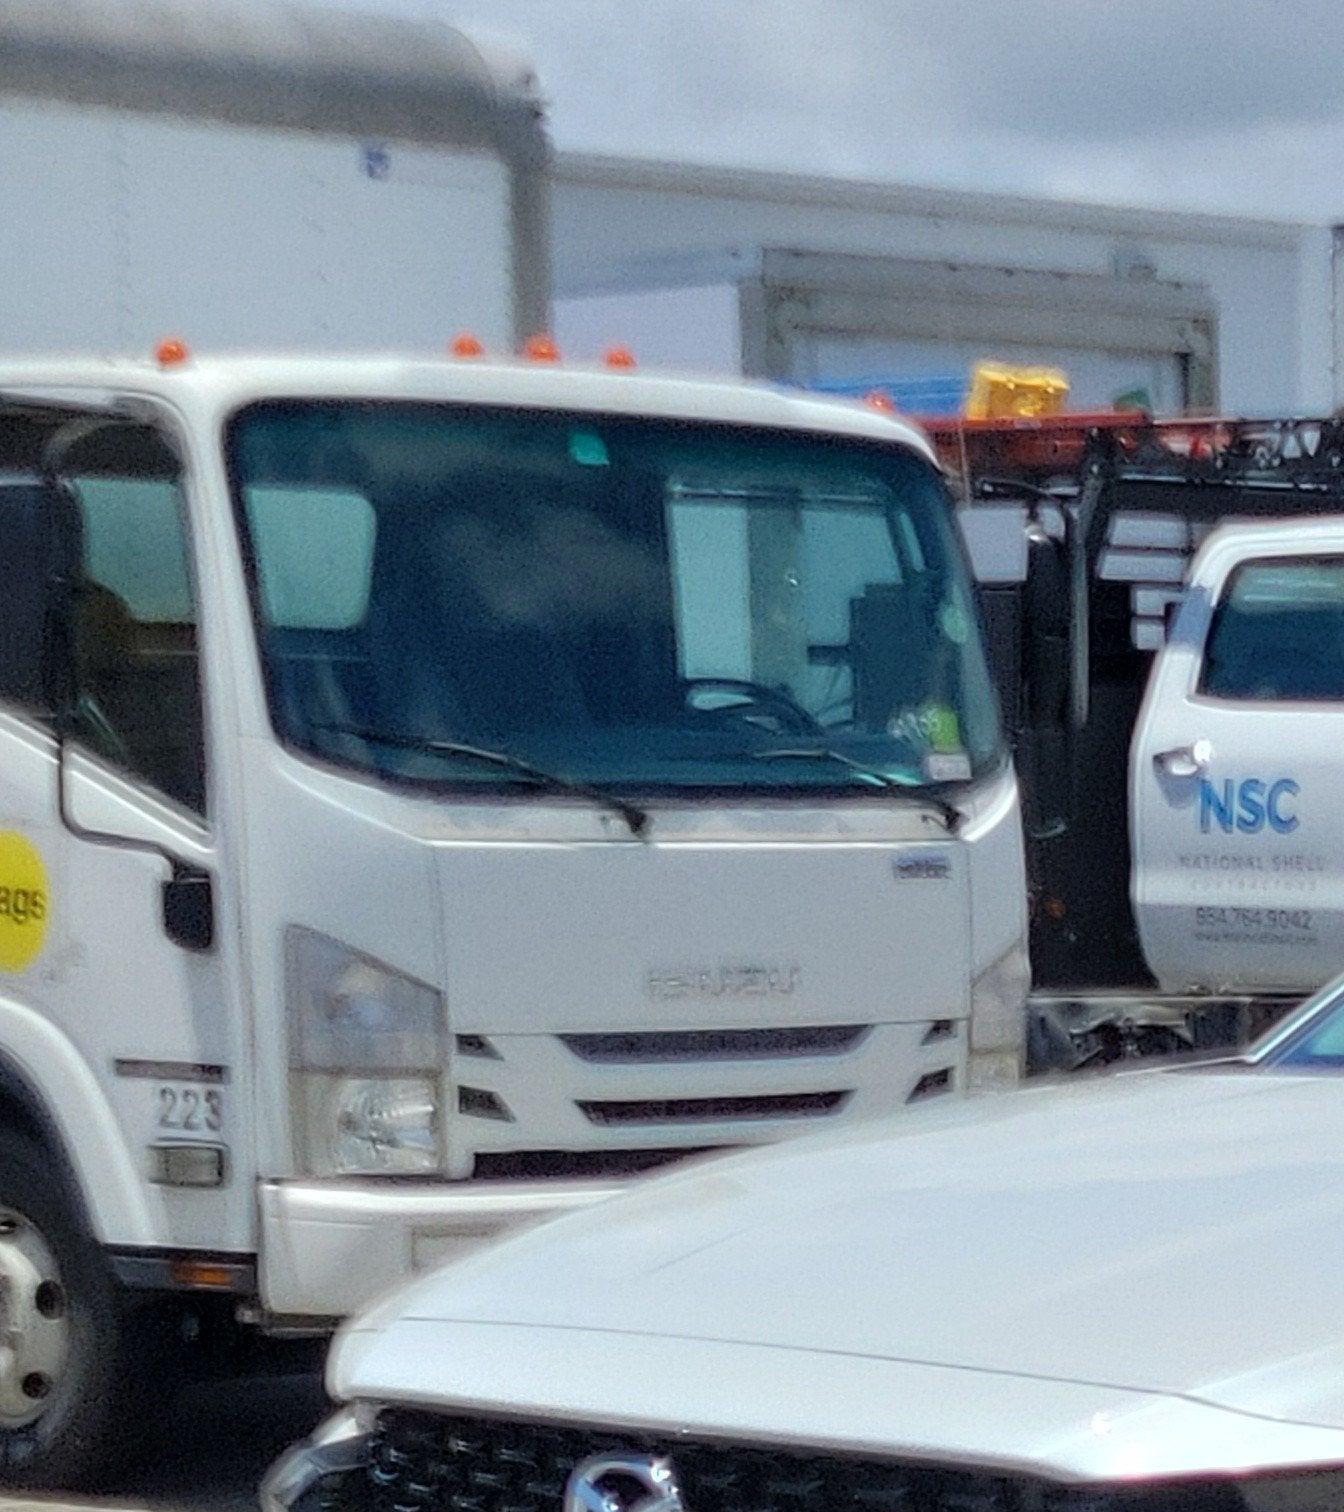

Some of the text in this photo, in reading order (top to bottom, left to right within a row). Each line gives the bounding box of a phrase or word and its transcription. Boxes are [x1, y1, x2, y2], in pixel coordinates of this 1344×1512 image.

[1200, 778, 1301, 835] NSC
[1178, 854, 1326, 873] NATIONAL SHELL
[159, 1087, 222, 1131] 223
